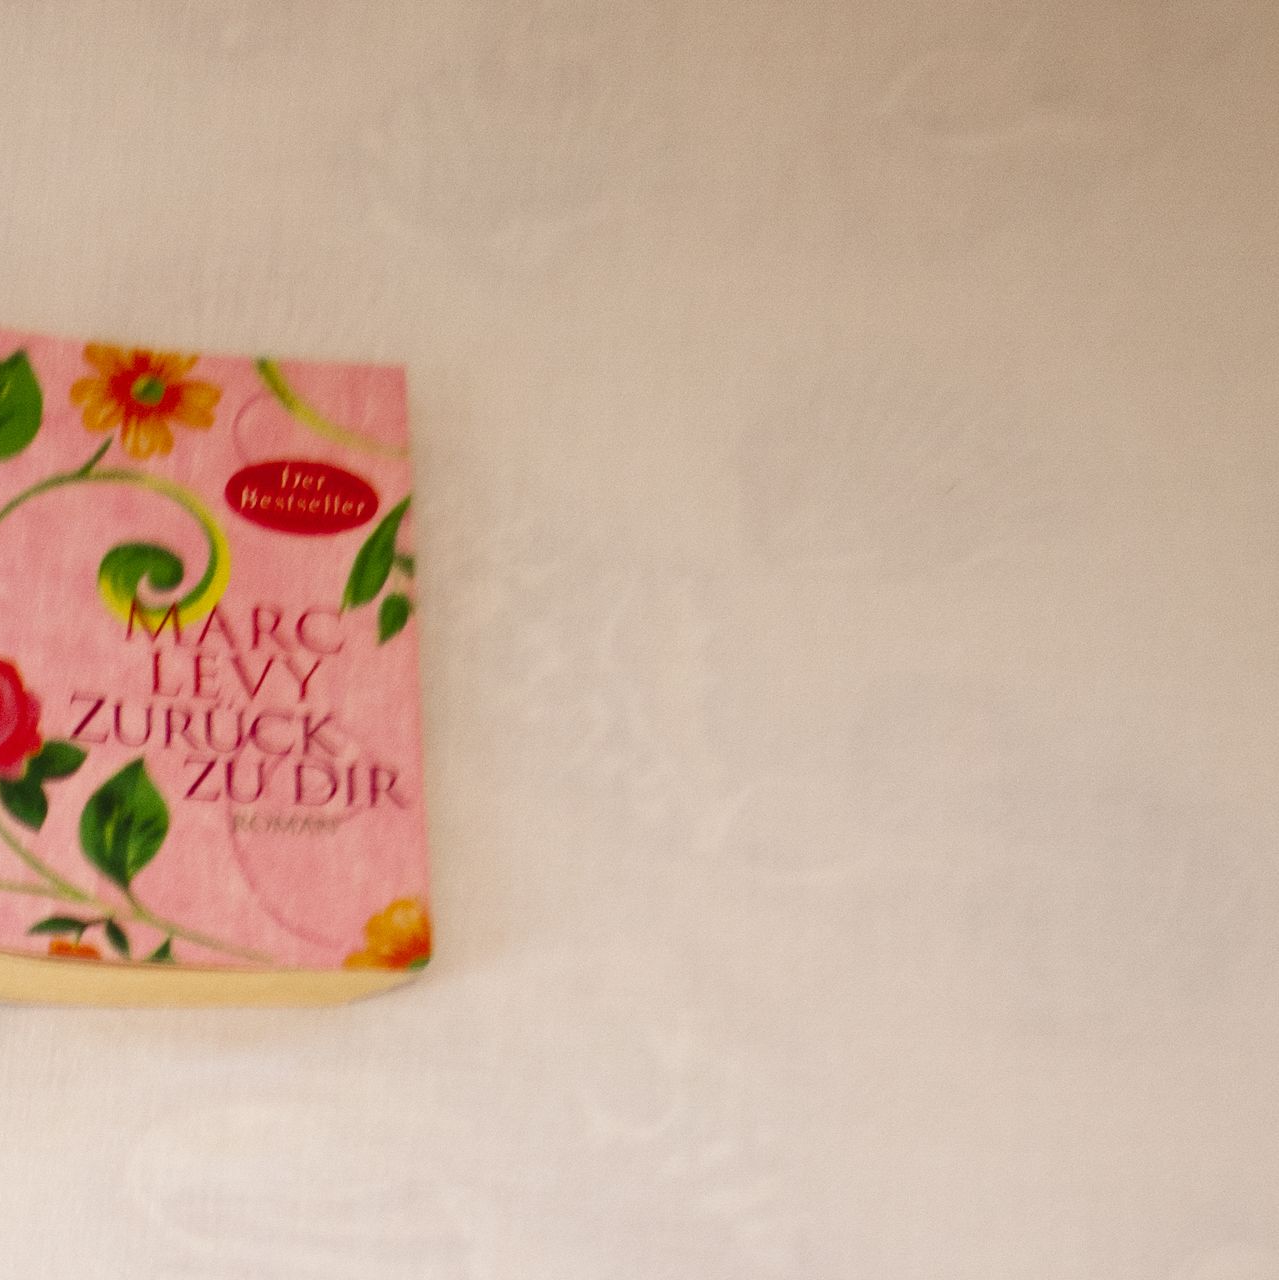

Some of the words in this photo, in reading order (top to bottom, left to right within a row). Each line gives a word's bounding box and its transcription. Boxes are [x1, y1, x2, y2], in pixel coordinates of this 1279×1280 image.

[240, 485, 365, 517] Bestseller
[125, 597, 346, 655] MARC
[150, 648, 322, 701] LEVY
[184, 755, 266, 805] ZU
[294, 757, 410, 810] DIR
